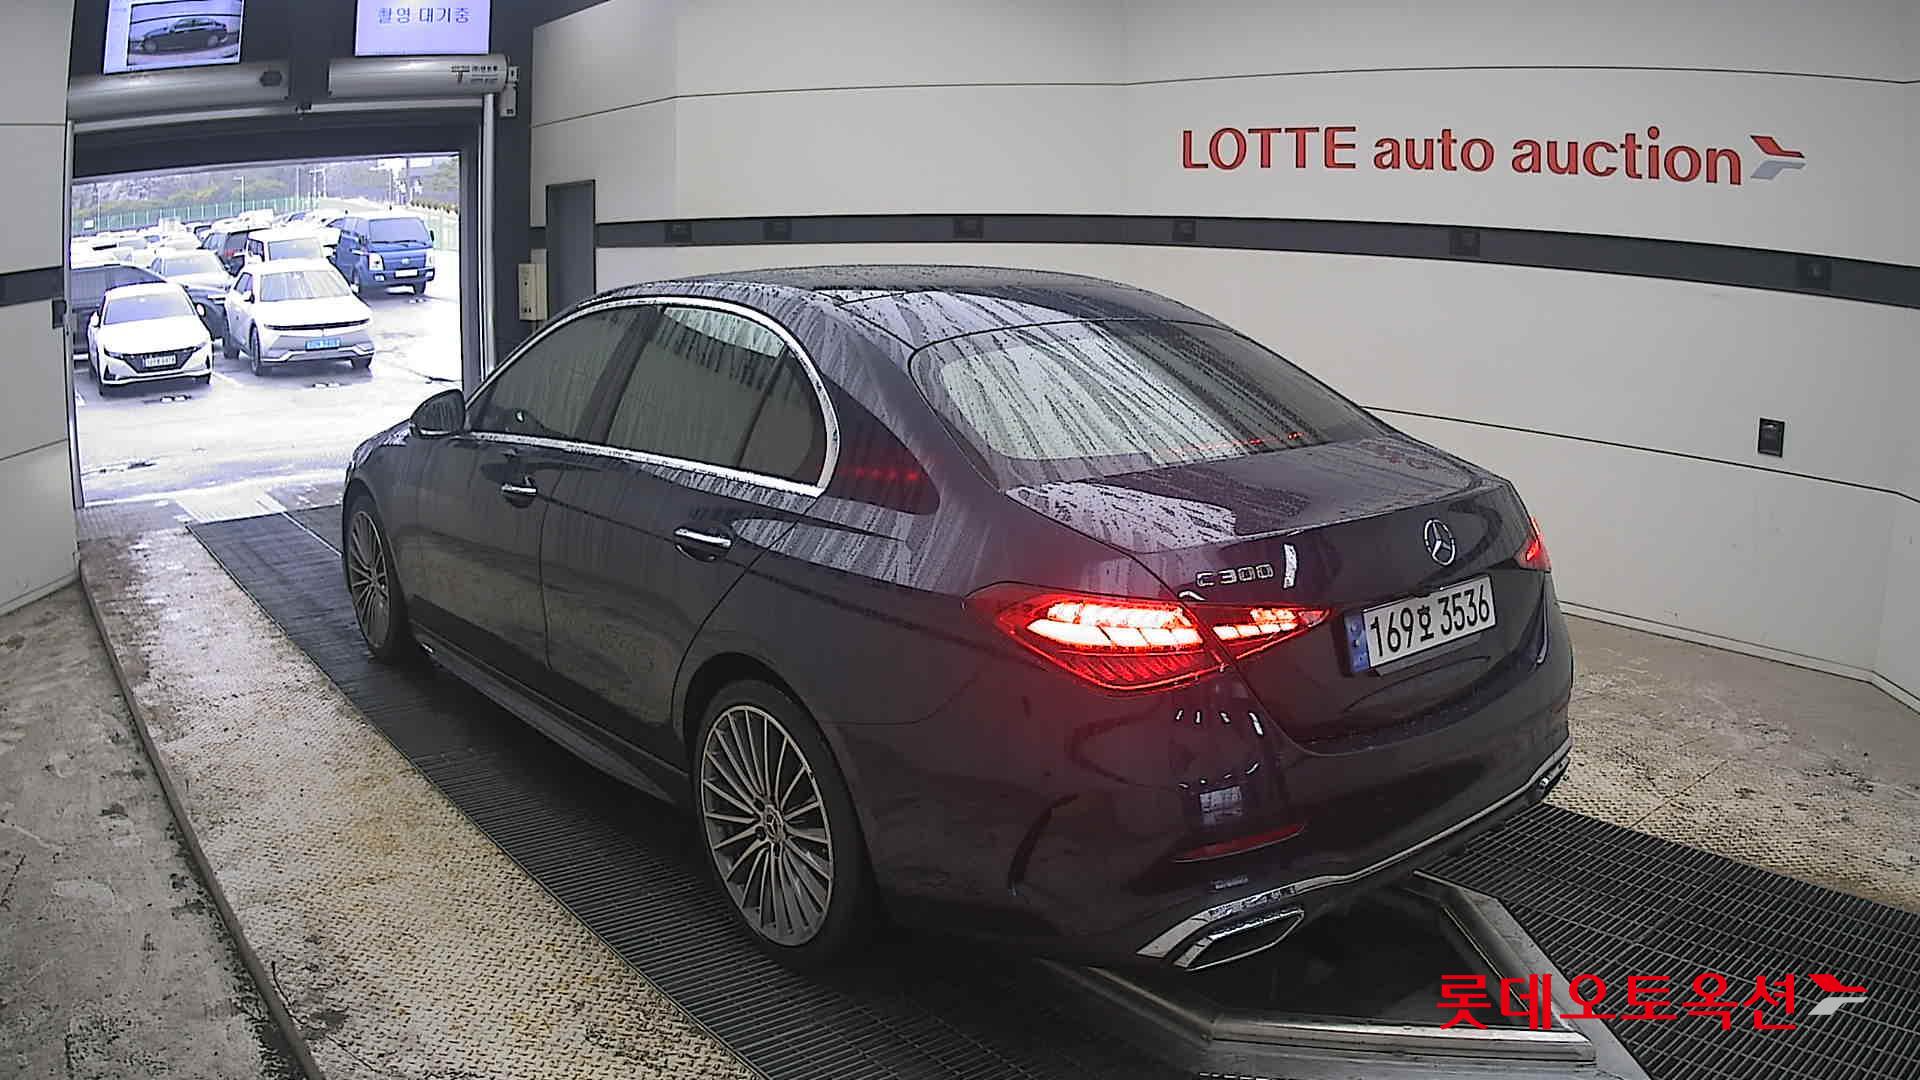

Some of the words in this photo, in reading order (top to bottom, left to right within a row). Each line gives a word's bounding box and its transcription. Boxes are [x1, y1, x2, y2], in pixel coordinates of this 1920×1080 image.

[418, 7, 471, 24] 대기중
[1181, 125, 1358, 170] LOTTE
[1373, 127, 1496, 172] auto
[1511, 125, 1743, 186] auction
[1196, 572, 1215, 587] C
[1219, 563, 1275, 584] 300
[1370, 604, 1435, 657] 169호
[1437, 584, 1490, 636] 3536
